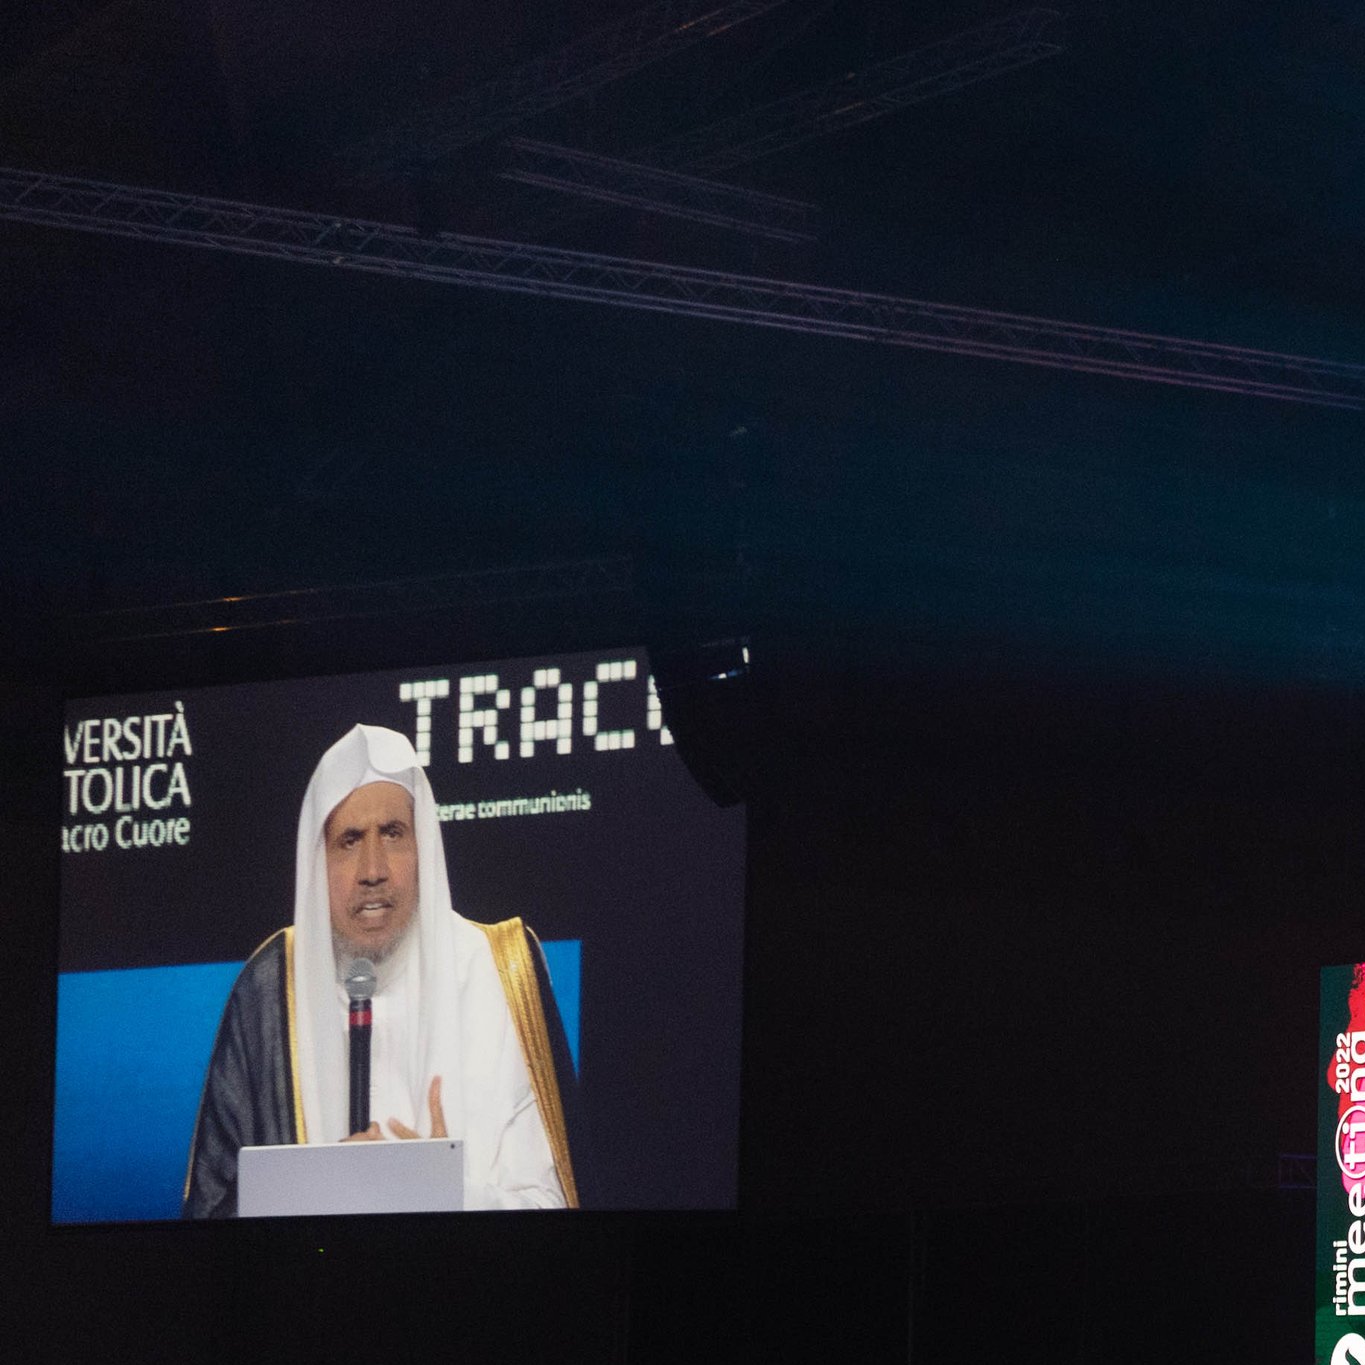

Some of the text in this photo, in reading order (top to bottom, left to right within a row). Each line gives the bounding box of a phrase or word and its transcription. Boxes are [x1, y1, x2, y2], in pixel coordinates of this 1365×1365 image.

[63, 762, 191, 816] TOLICA
[115, 815, 191, 849] Cuore
[1336, 1032, 1350, 1094] 2022
[1333, 1240, 1347, 1316] rimini
